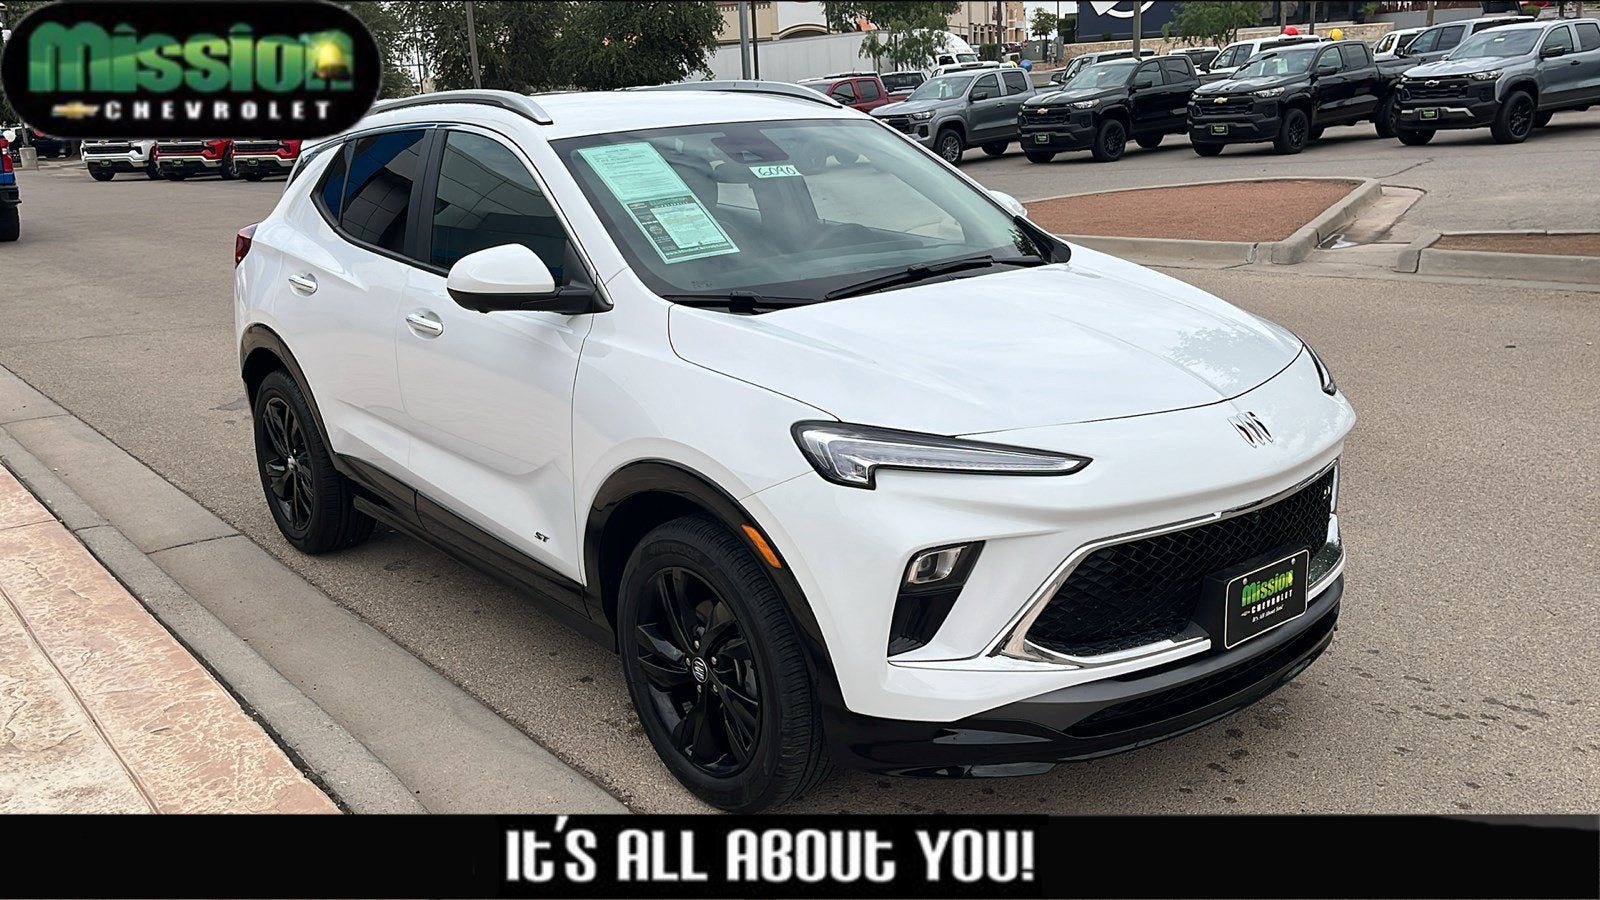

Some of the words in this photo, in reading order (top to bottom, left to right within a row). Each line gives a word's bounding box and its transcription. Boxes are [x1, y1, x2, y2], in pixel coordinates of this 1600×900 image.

[758, 166, 796, 176] 6090
[534, 531, 550, 543] ST
[1241, 569, 1294, 607] Mission
[1251, 589, 1293, 614] CHEVROLET
